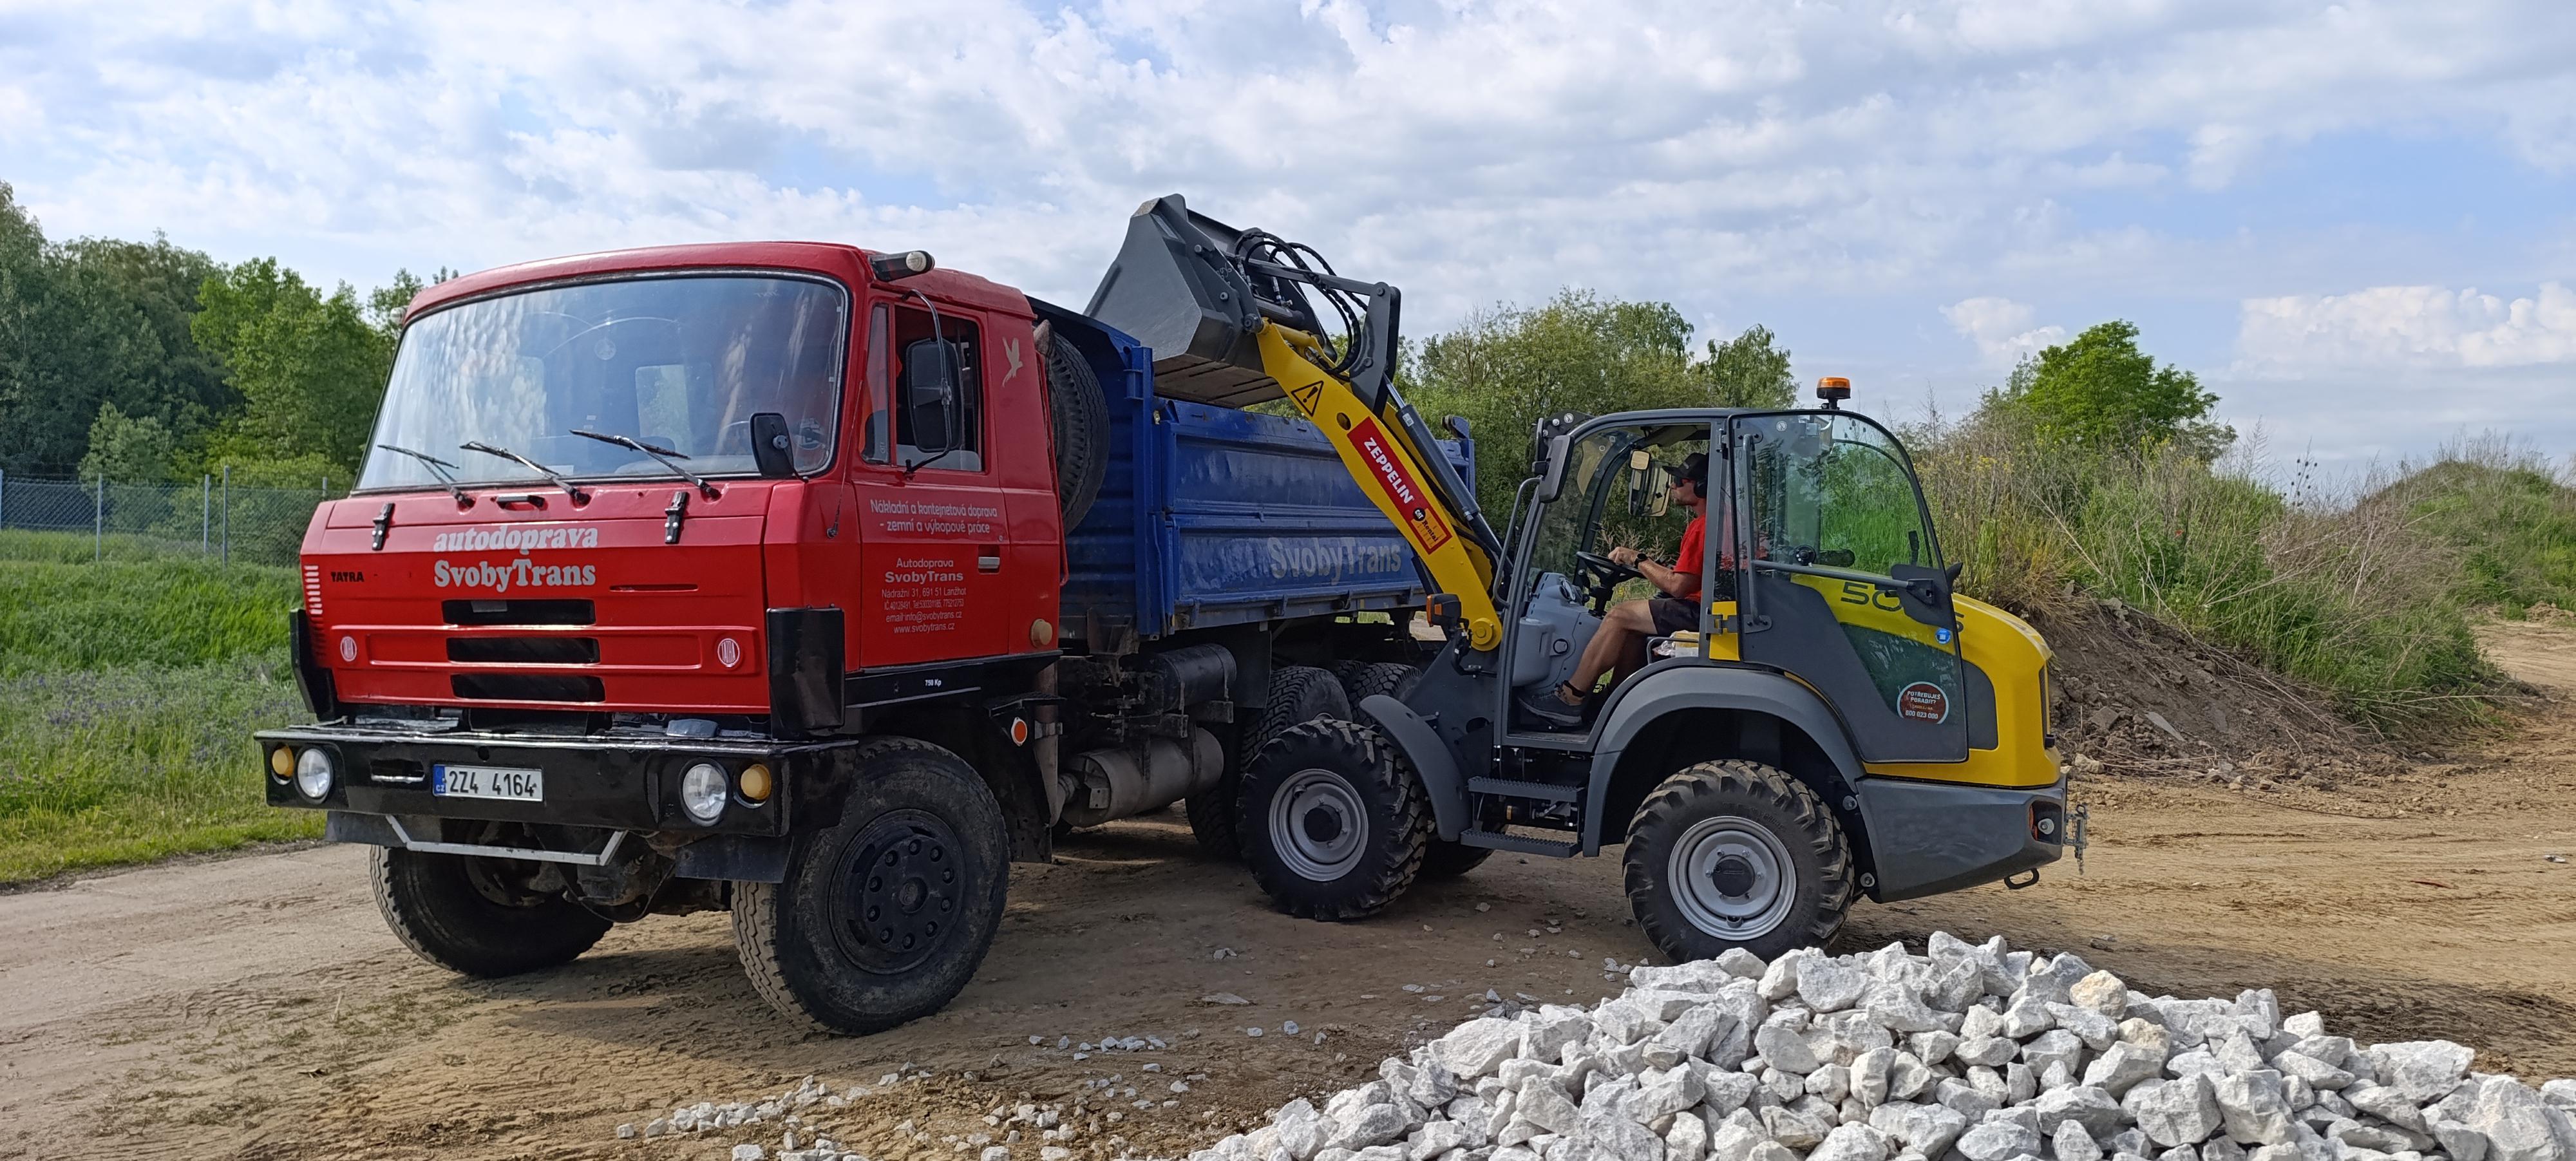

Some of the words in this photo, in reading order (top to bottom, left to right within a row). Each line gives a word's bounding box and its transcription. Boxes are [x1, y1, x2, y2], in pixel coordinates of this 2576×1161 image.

[1364, 437, 1414, 504] ZEPPELIN
[870, 500, 909, 514] Nákladní
[911, 504, 916, 514] a
[968, 504, 998, 518] doprava
[887, 518, 914, 532] zemní
[916, 523, 922, 532] a
[925, 520, 965, 534] výkopové
[968, 521, 990, 534] práce
[1414, 509, 1424, 519] CAT
[1422, 520, 1439, 542] Rental
[433, 525, 598, 555] autodoprava
[896, 558, 954, 569] Autodoprava
[1267, 537, 1402, 585] SvobyTrans
[330, 571, 365, 582] TATRA
[434, 558, 596, 592] SvobyTrans
[885, 571, 964, 585] SvobyTrans
[943, 587, 966, 596] Lanžhot
[893, 623, 955, 634] www.svobytrans.cz
[450, 771, 478, 794] 2Z4
[492, 773, 534, 797] 4164
